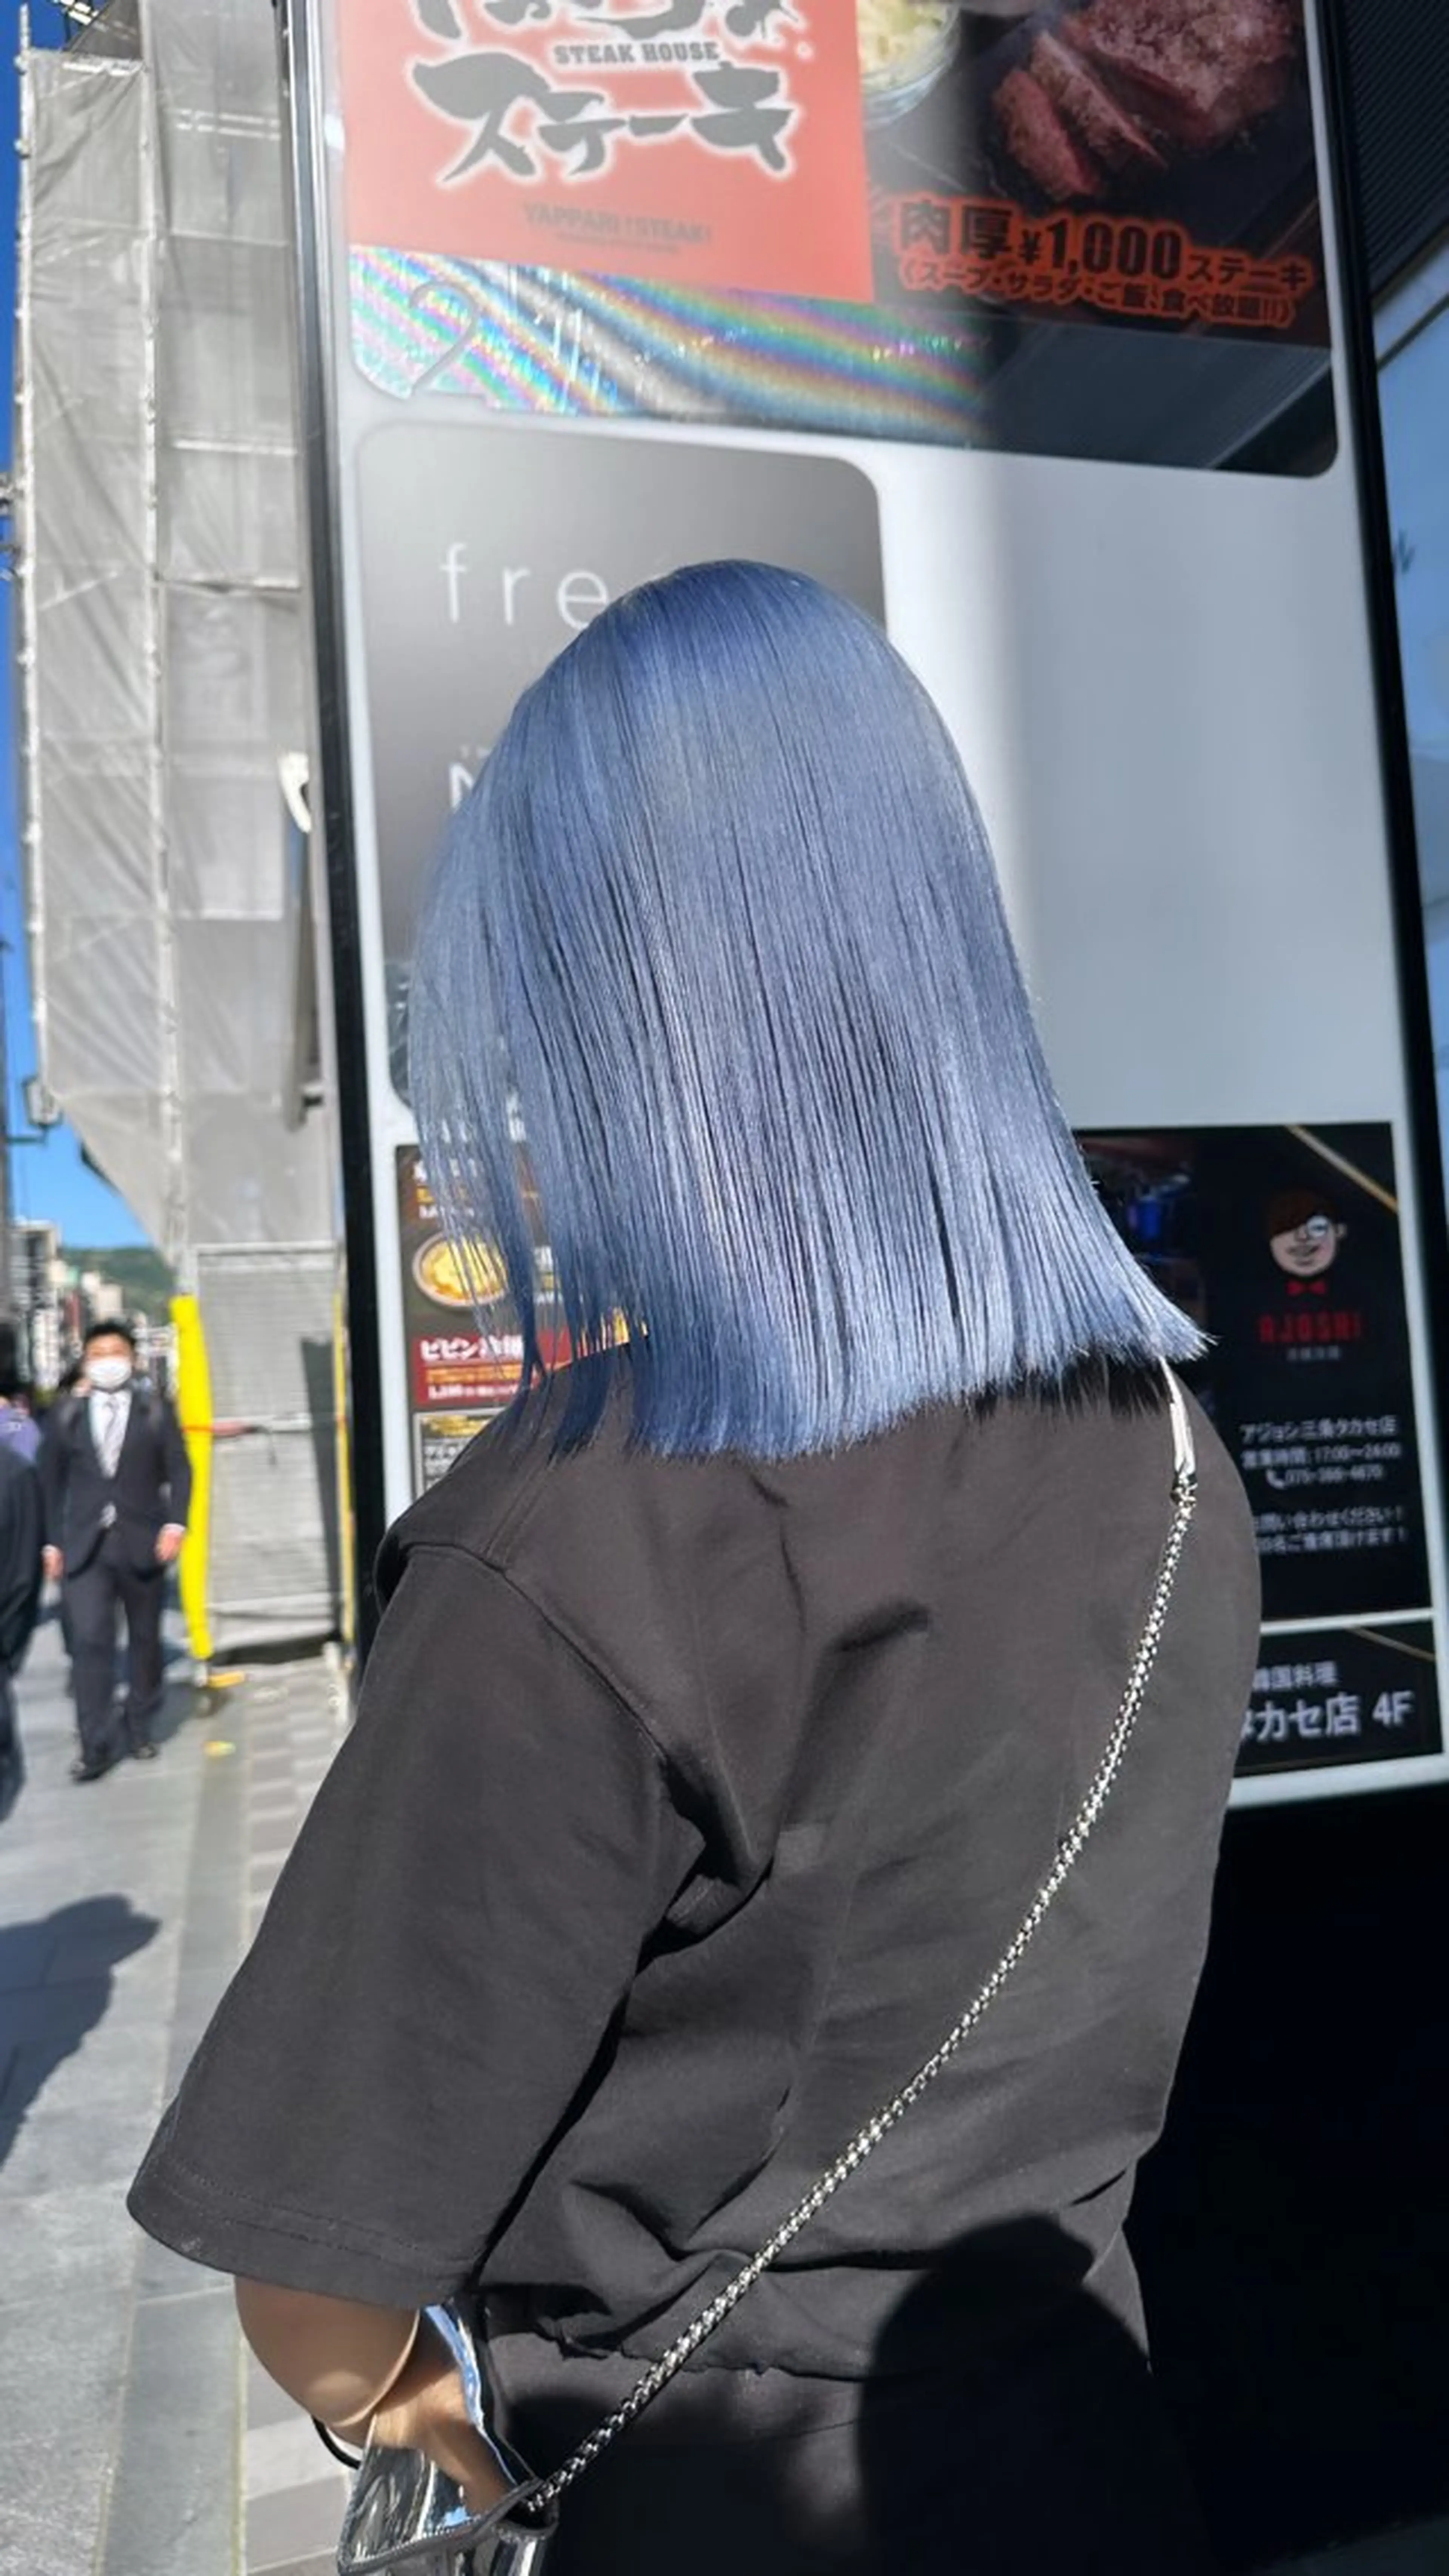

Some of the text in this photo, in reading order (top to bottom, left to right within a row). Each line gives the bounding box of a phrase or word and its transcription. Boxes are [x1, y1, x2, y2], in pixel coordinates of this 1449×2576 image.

[553, 41, 719, 65] STEAK HOUSE
[411, 51, 795, 183] ステーキ
[440, 542, 672, 631] fre
[1371, 1690, 1415, 1727] 4F
